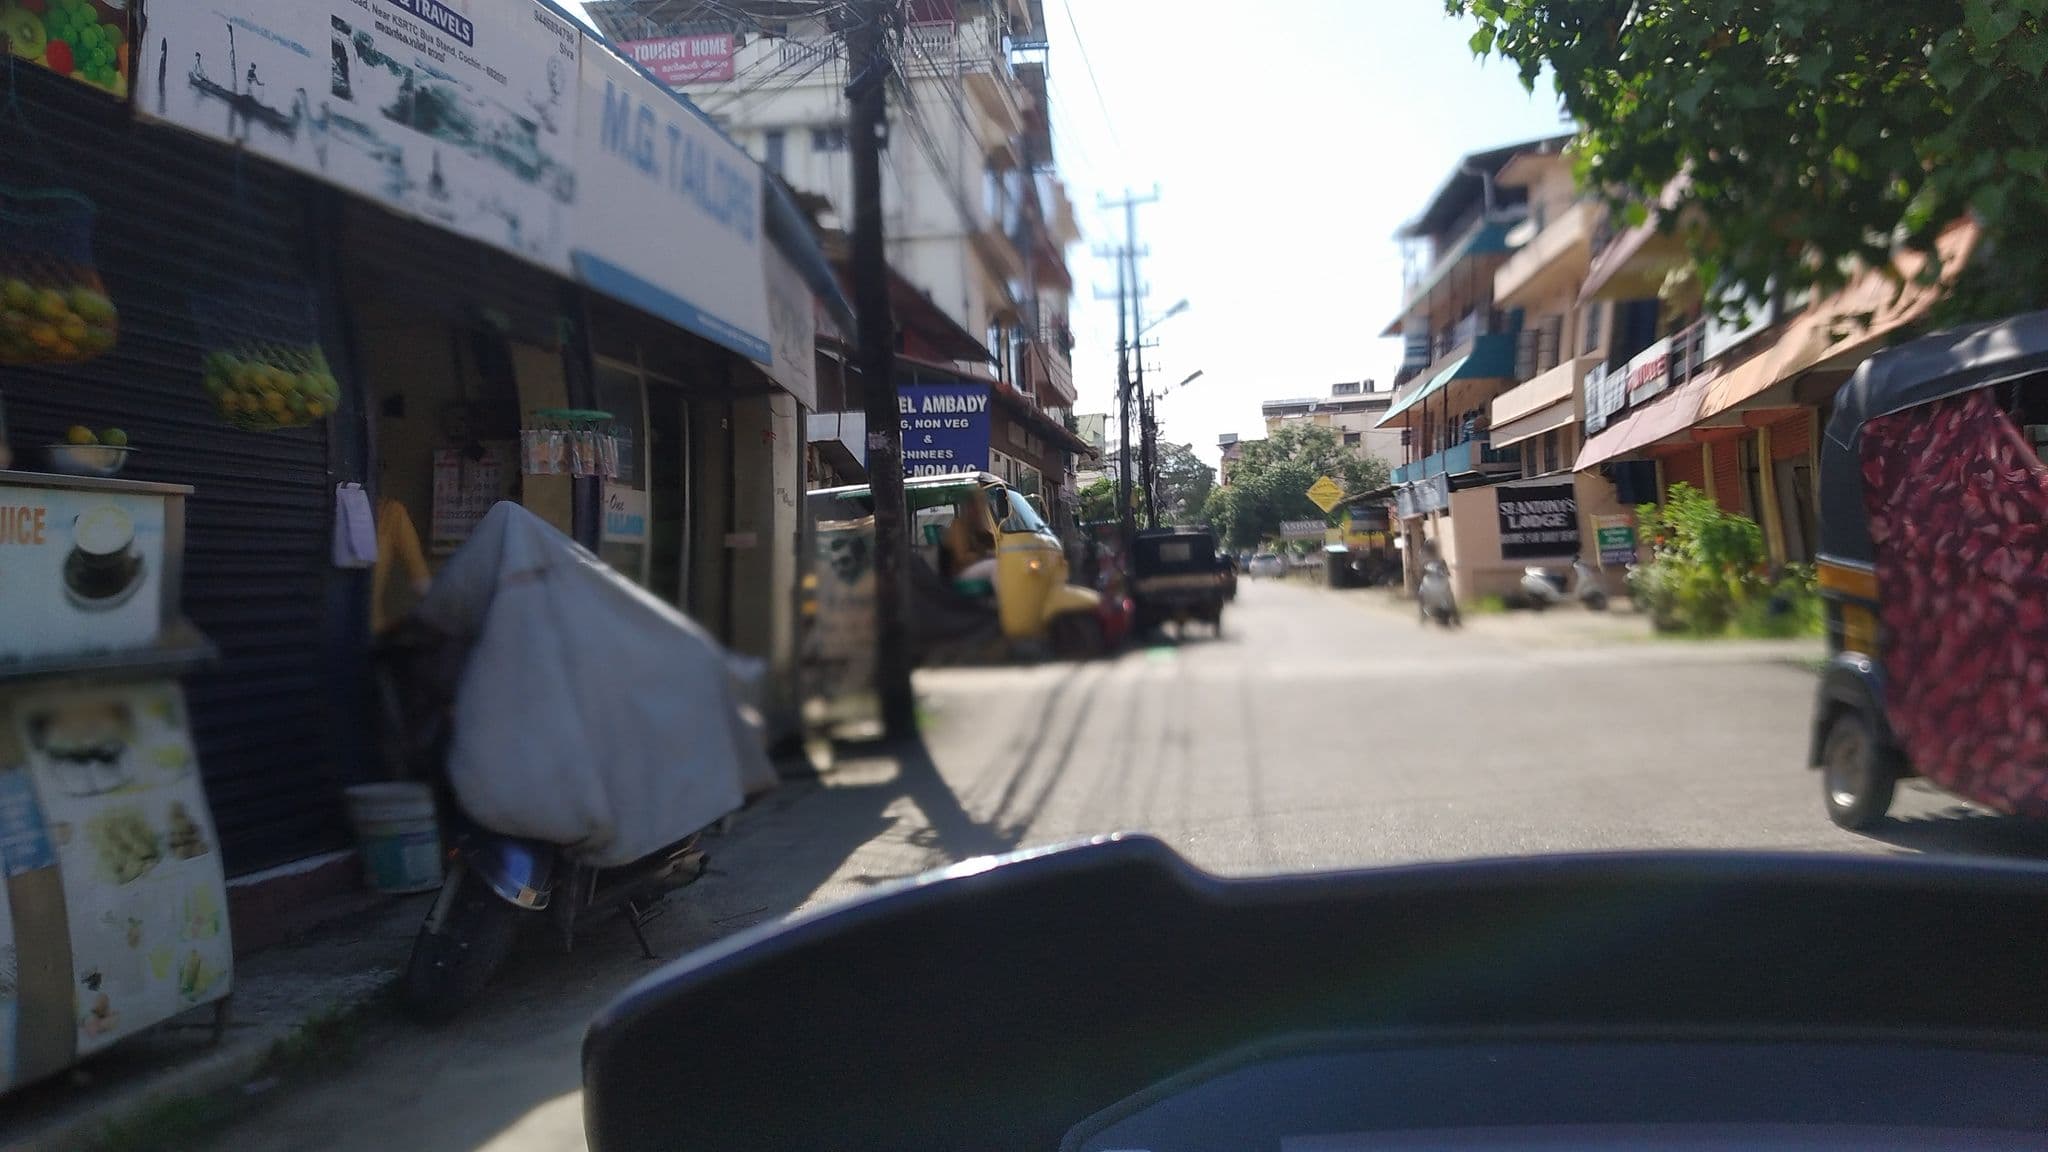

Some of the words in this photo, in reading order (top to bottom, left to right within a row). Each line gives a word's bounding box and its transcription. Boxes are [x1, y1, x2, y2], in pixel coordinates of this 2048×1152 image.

[350, 0, 370, 11] oad,
[371, 3, 391, 20] Near
[392, 14, 418, 36] KSRTC
[420, 28, 434, 44] Bus
[634, 41, 687, 60] TOURIST
[691, 38, 727, 57] HOME
[922, 395, 987, 413] AMBADY
[915, 419, 941, 428] NON
[944, 419, 969, 428] VEG
[923, 434, 933, 444] &
[1508, 513, 1569, 529] LODGE
